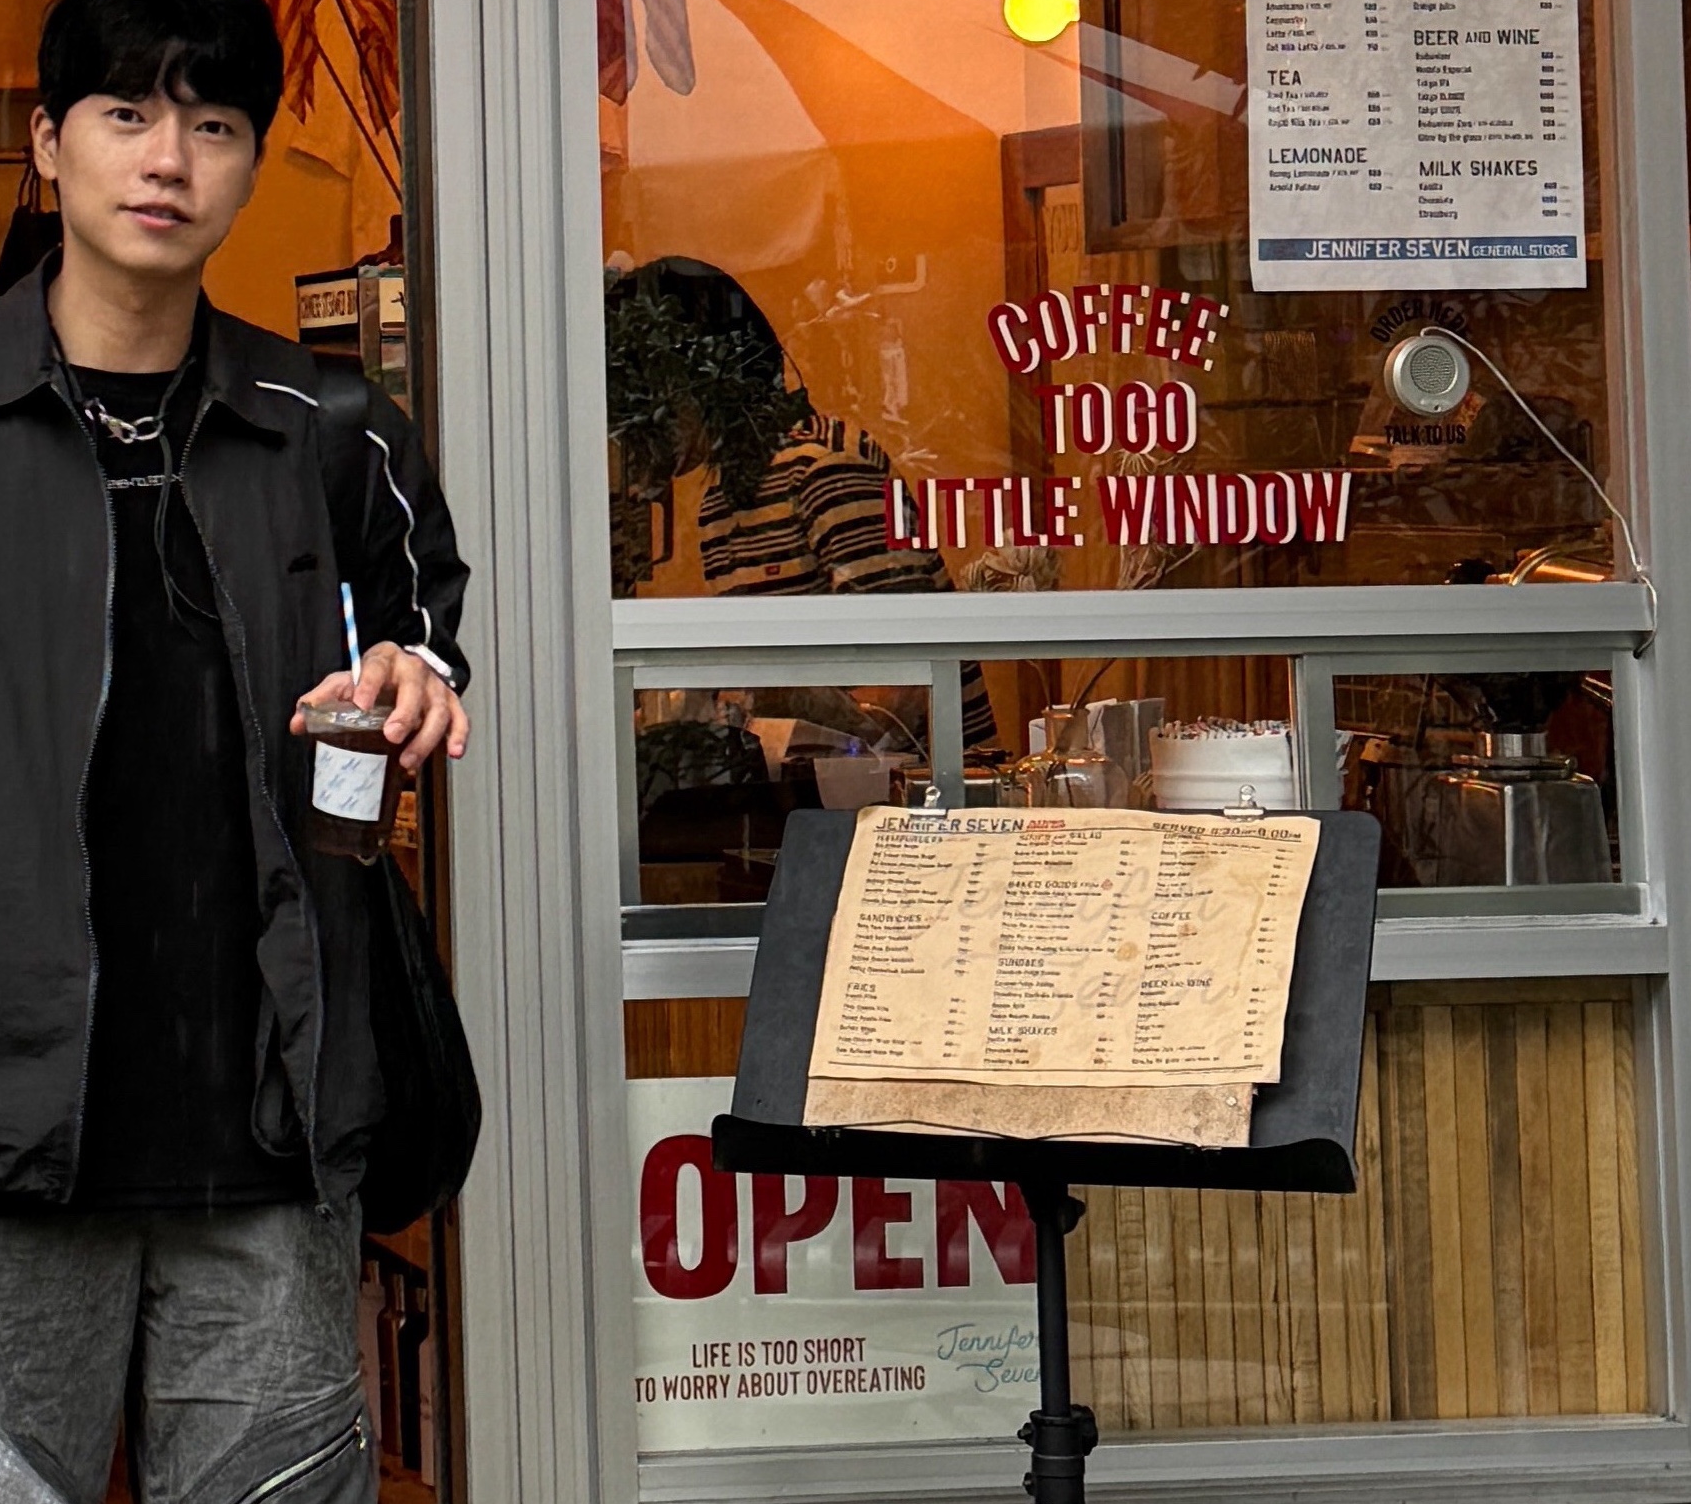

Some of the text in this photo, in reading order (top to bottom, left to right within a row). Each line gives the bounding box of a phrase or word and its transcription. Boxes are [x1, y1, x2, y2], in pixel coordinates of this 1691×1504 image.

[1413, 28, 1540, 46] BEER AND WINE
[1267, 70, 1302, 85] TEA
[1269, 147, 1368, 164] LEMONADE
[1419, 160, 1539, 177] MILK SHAKES
[1305, 238, 1569, 259] JENNIFER SEVEN GENERAL STORE
[987, 283, 1230, 374] COFFEE
[1369, 298, 1425, 343] ORDER
[1384, 424, 1466, 445] TALK TO US
[885, 471, 1353, 551] LITTLE WINDOW
[966, 818, 1025, 832] SEVEN
[640, 1134, 1037, 1300] OPEN
[691, 1337, 867, 1368] LIFE IS TOO SHORT
[635, 1365, 926, 1404] TO WORRY ABOUT OVEREATING
